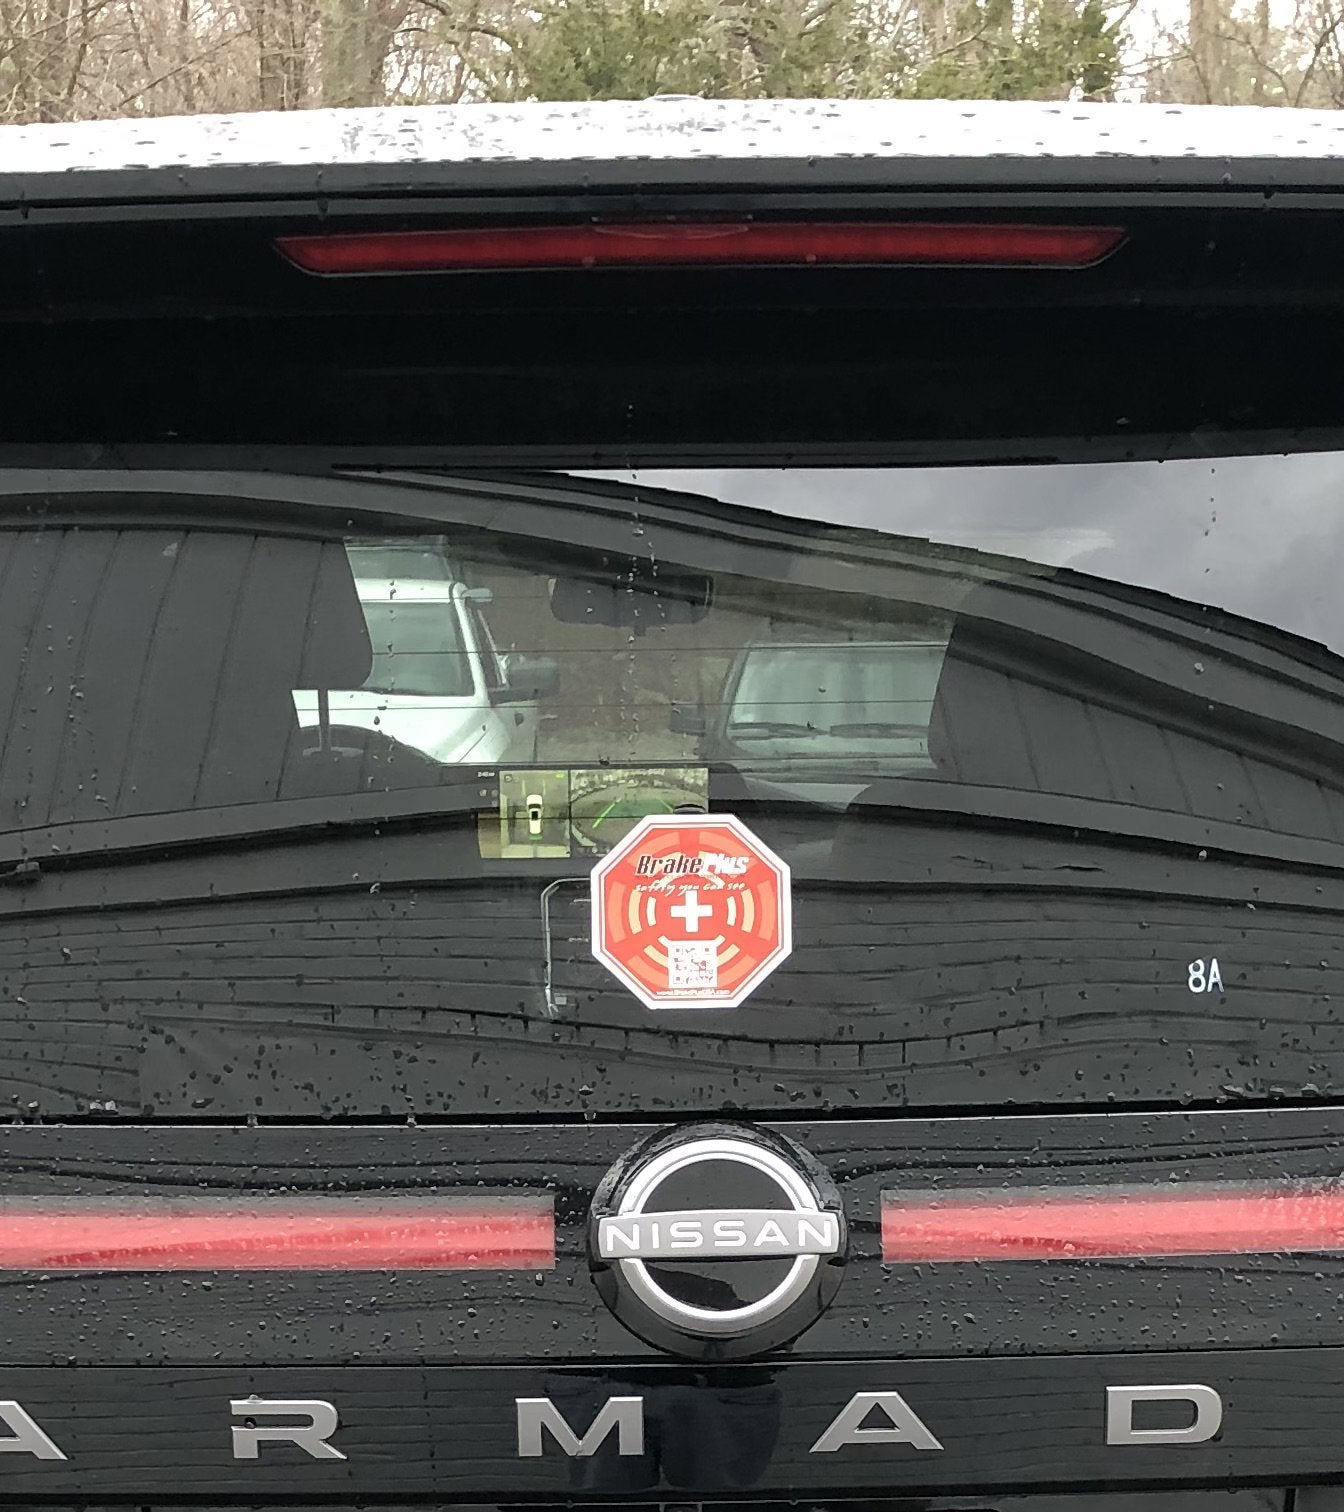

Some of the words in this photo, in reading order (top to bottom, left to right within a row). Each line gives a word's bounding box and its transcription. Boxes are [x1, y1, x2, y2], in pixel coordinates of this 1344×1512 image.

[636, 880, 675, 897] safety
[677, 884, 700, 896] you
[703, 883, 724, 891] can
[727, 882, 746, 891] see
[1188, 957, 1225, 993] 8A
[606, 1220, 832, 1251] NISSAN
